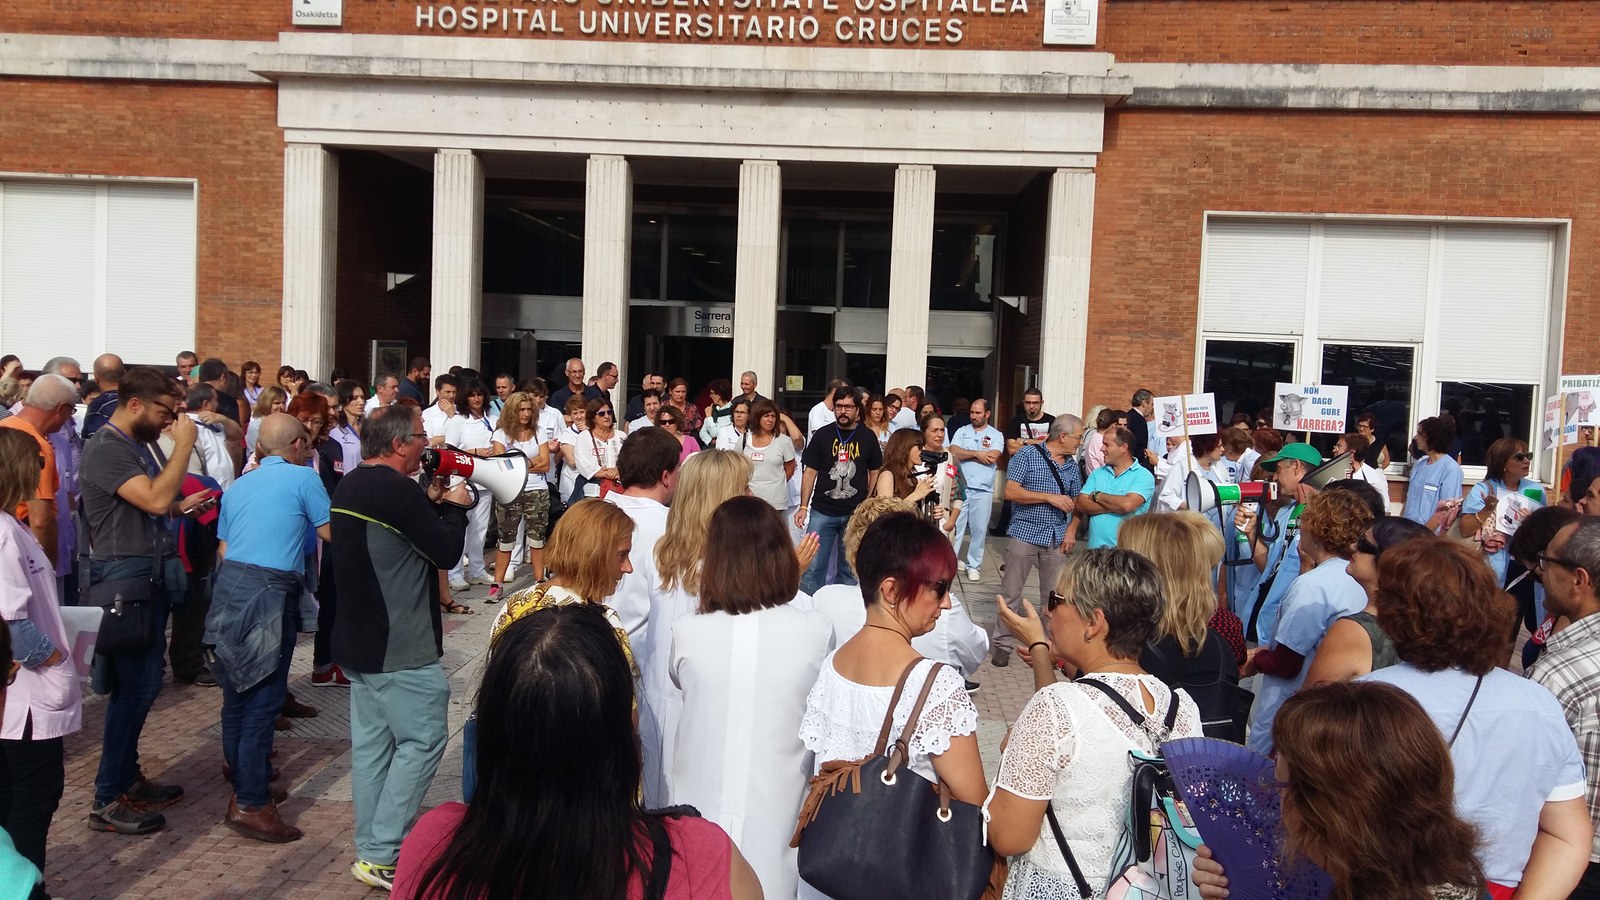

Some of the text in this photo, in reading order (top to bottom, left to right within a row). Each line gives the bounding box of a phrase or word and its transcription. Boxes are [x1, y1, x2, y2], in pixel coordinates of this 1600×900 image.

[295, 10, 338, 18] Osakidetza
[415, 5, 963, 42] HOSPITAL UNIVERSITARIO CRUCES
[694, 310, 731, 321] Sarrera
[694, 323, 731, 334] Entrada
[1303, 386, 1320, 395] NON
[1311, 397, 1333, 405] DAGO
[1321, 408, 1341, 416] GURE
[1296, 418, 1344, 432] KARRERA?
[1173, 861, 1185, 897] Poupée
